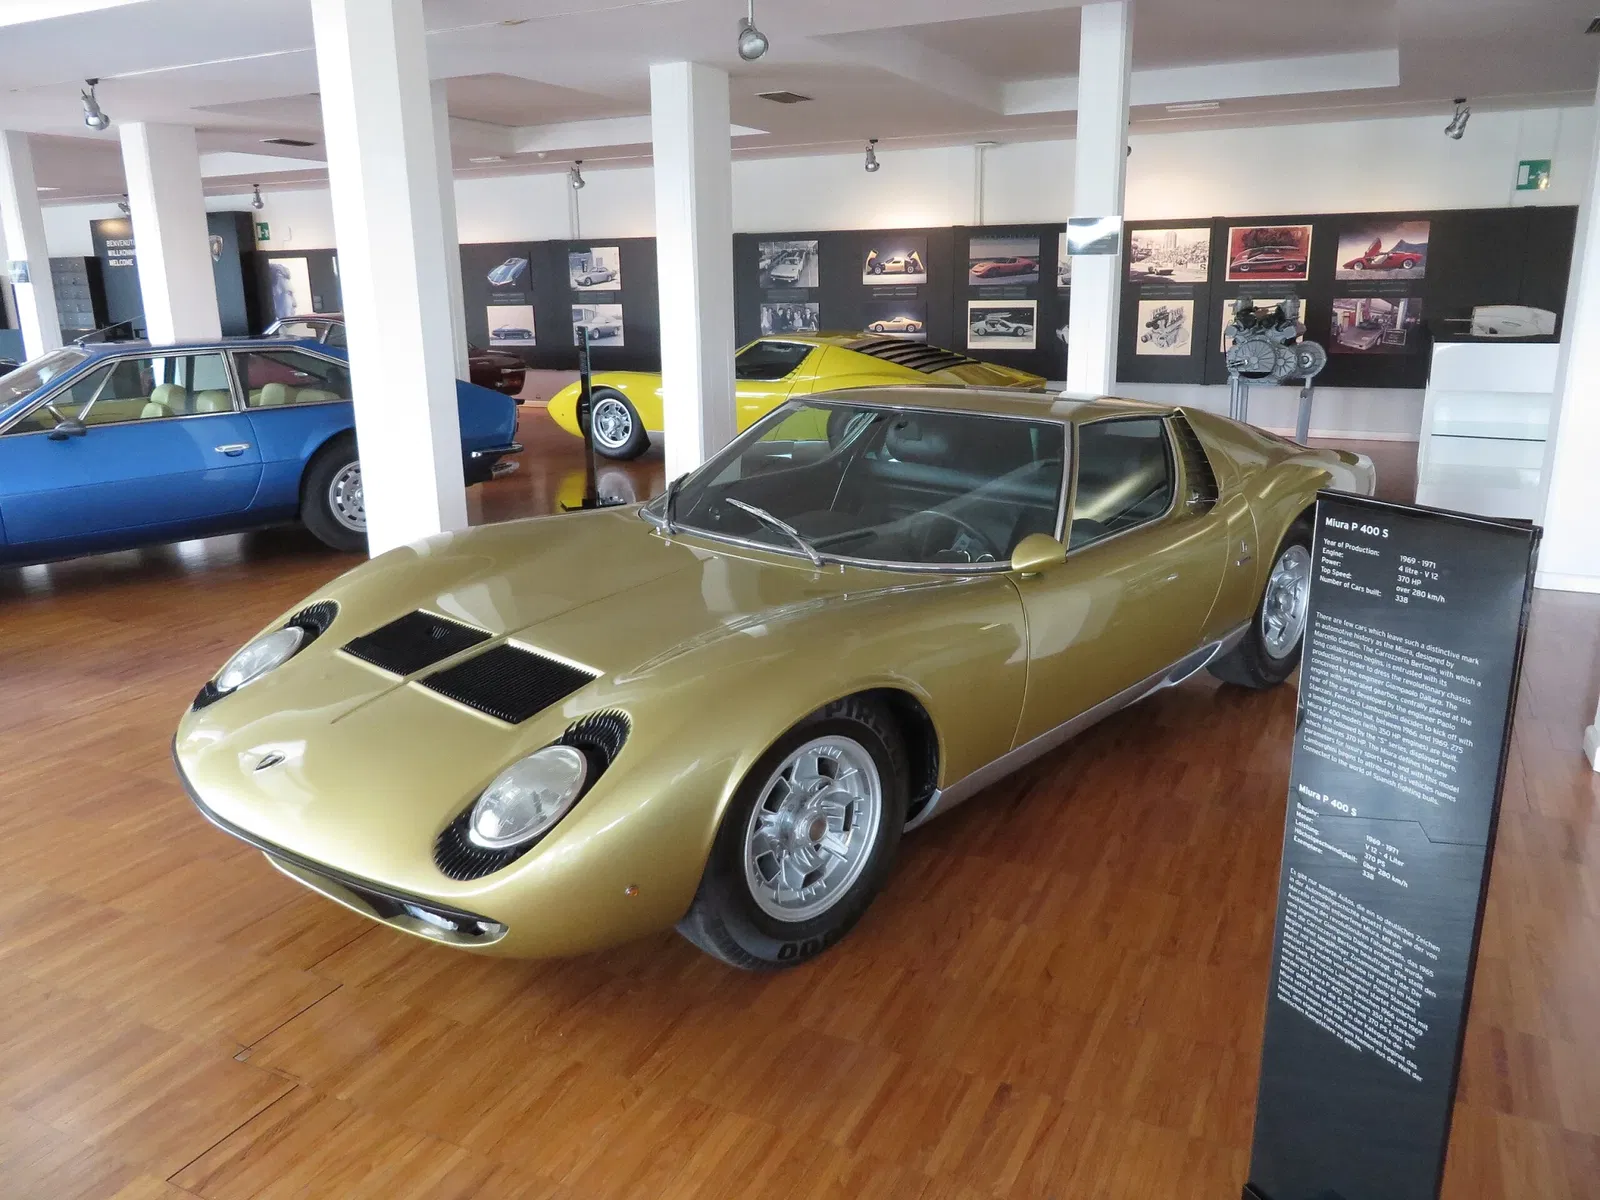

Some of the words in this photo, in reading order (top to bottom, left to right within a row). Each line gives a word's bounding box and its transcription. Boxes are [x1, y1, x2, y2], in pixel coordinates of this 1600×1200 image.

[106, 239, 135, 247] BENVENUT
[1325, 517, 1350, 530] Miura
[1360, 524, 1380, 536] 400
[1322, 547, 1344, 559] Engine:
[1323, 538, 1337, 547] Year
[1344, 542, 1380, 557] Production:
[1321, 556, 1341, 568] Power:
[1400, 555, 1417, 565] 1969
[1421, 560, 1436, 570] 1971
[1321, 566, 1331, 576] Top
[1331, 568, 1352, 580] Speed:
[1404, 566, 1419, 576] litre
[1430, 572, 1439, 581] 12
[1320, 575, 1343, 587] Number
[1350, 583, 1365, 593] Cars
[1365, 587, 1382, 597] built:
[1397, 574, 1411, 584] 370
[1411, 578, 1422, 587] HP
[1395, 594, 1409, 604] 338
[1396, 586, 1411, 595] over
[1412, 589, 1427, 599] 280
[1427, 592, 1446, 603] km/h
